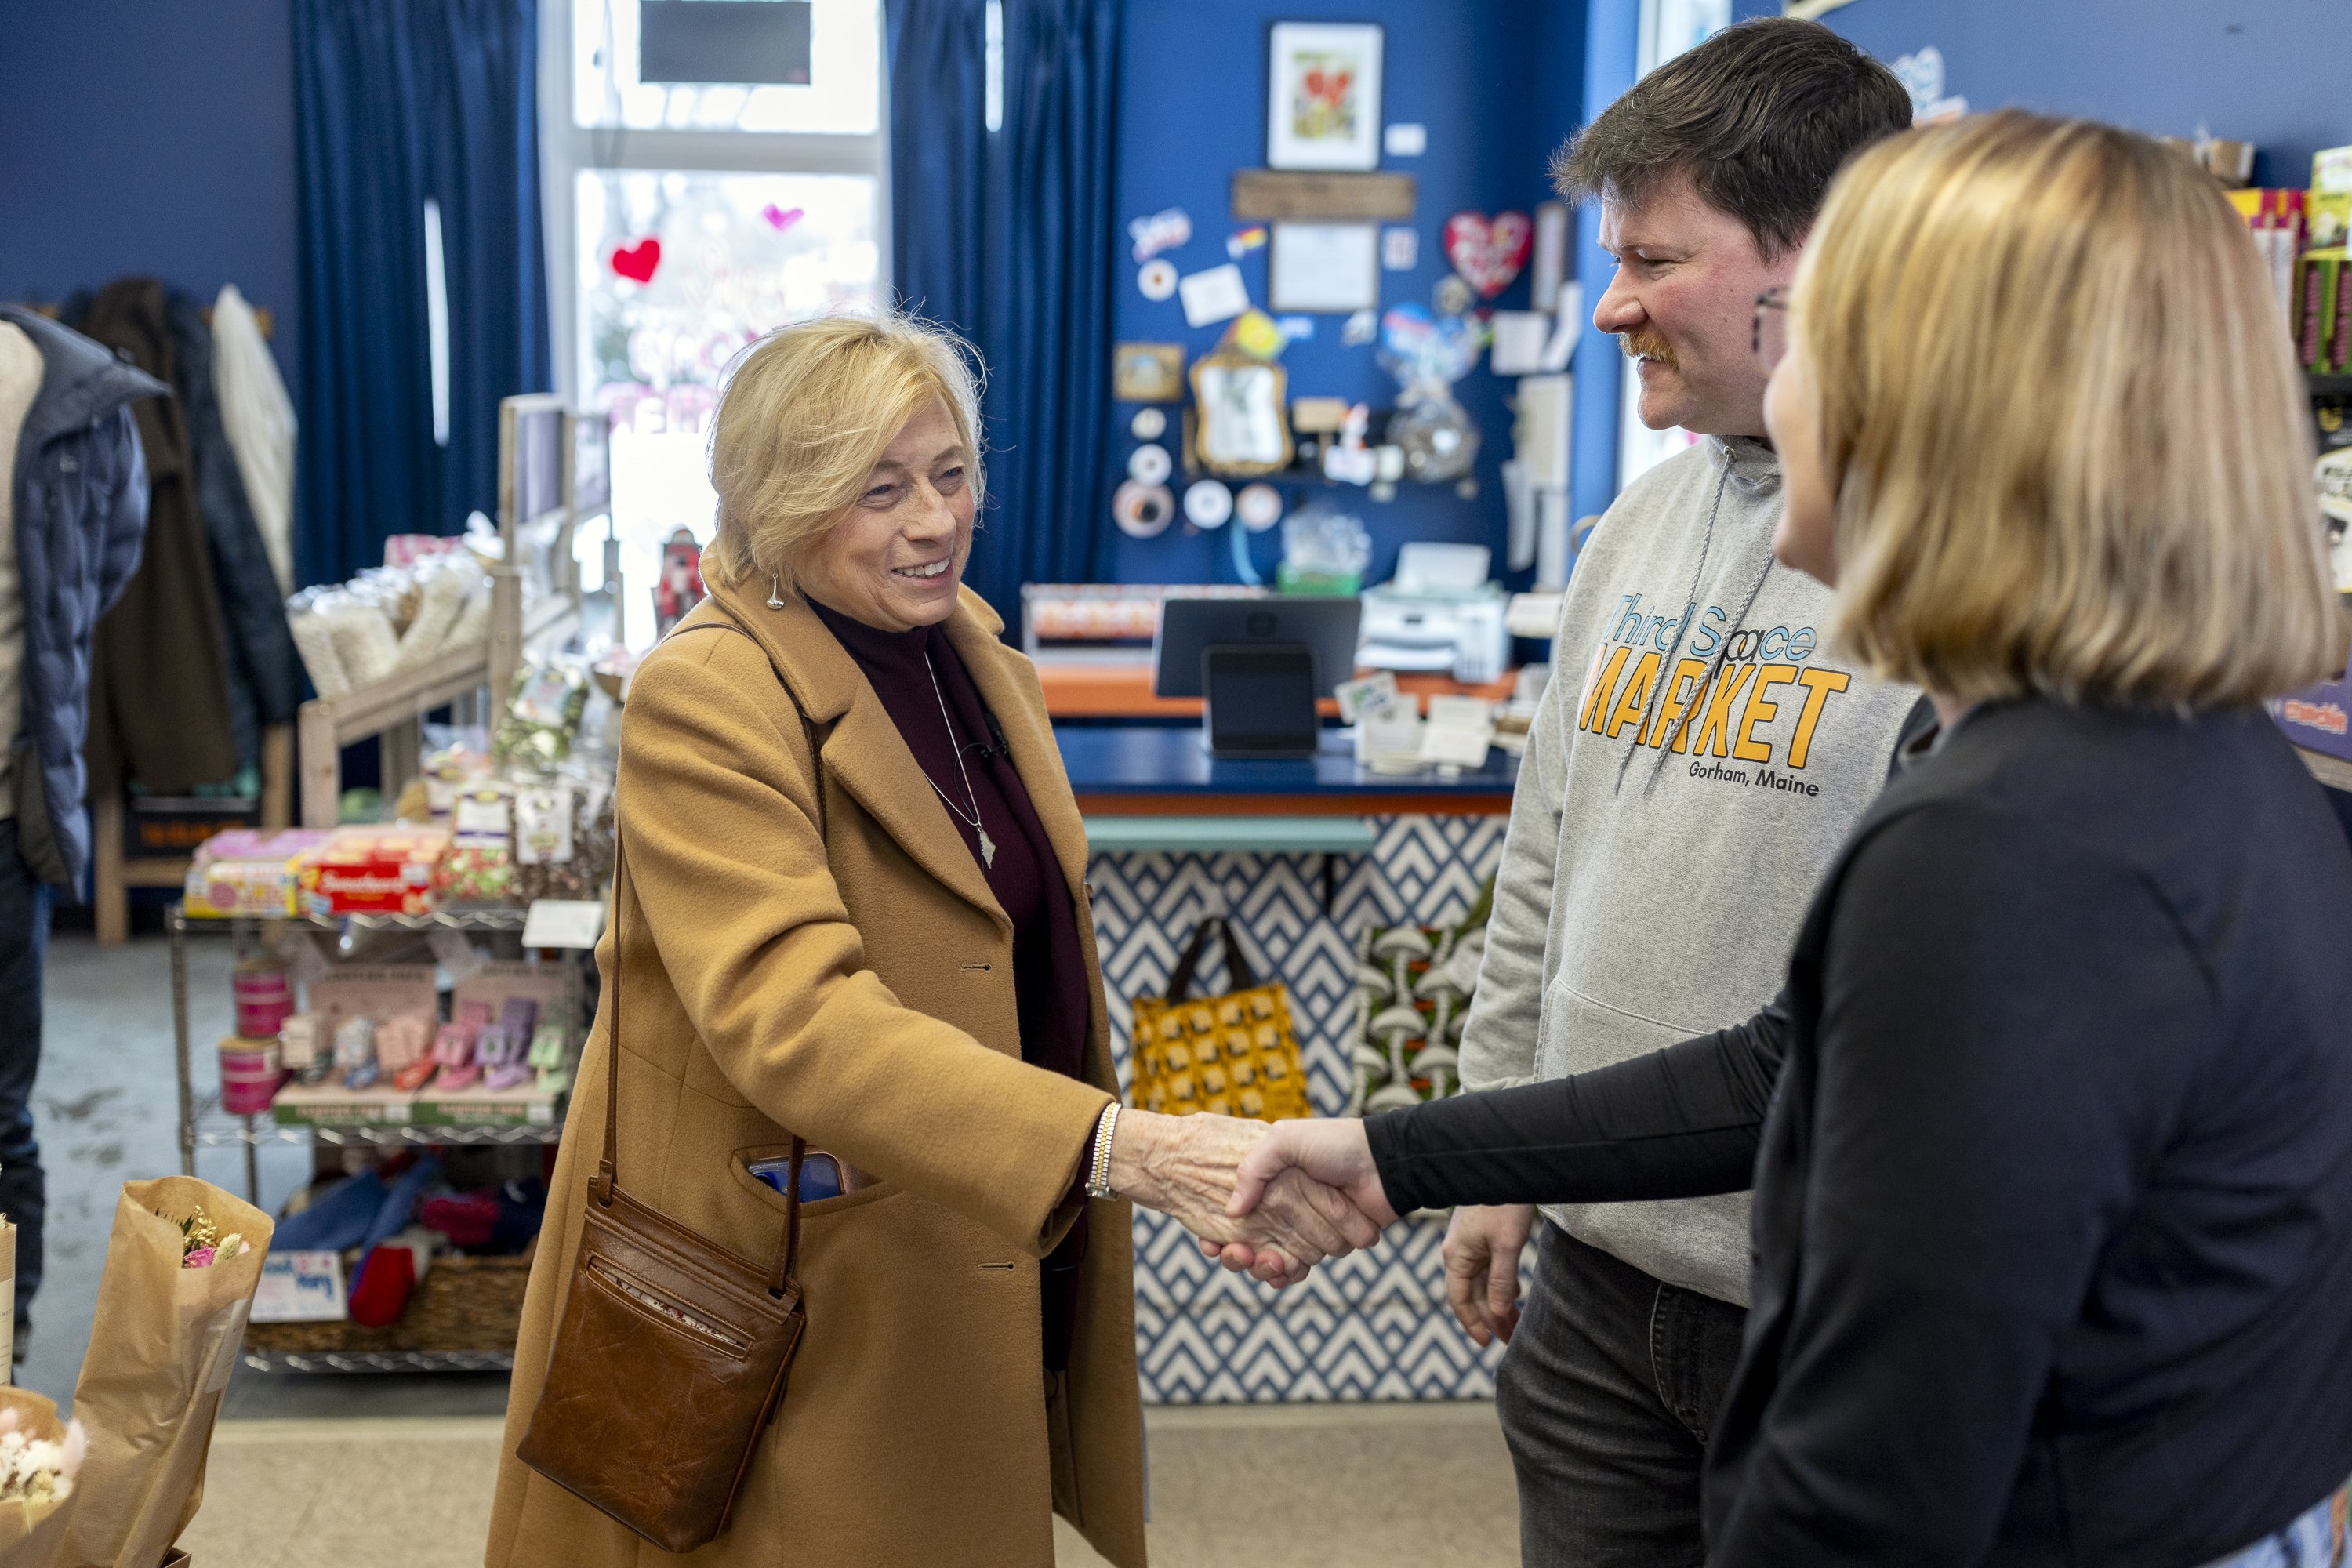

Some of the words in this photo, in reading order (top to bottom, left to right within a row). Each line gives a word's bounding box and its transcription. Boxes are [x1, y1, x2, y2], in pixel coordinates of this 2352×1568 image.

[1604, 593, 1696, 653] Third
[1690, 606, 1817, 680] Space
[1579, 642, 1852, 769] MARKET
[1689, 760, 1749, 787] Gorham,
[1755, 769, 1820, 797] Maine
